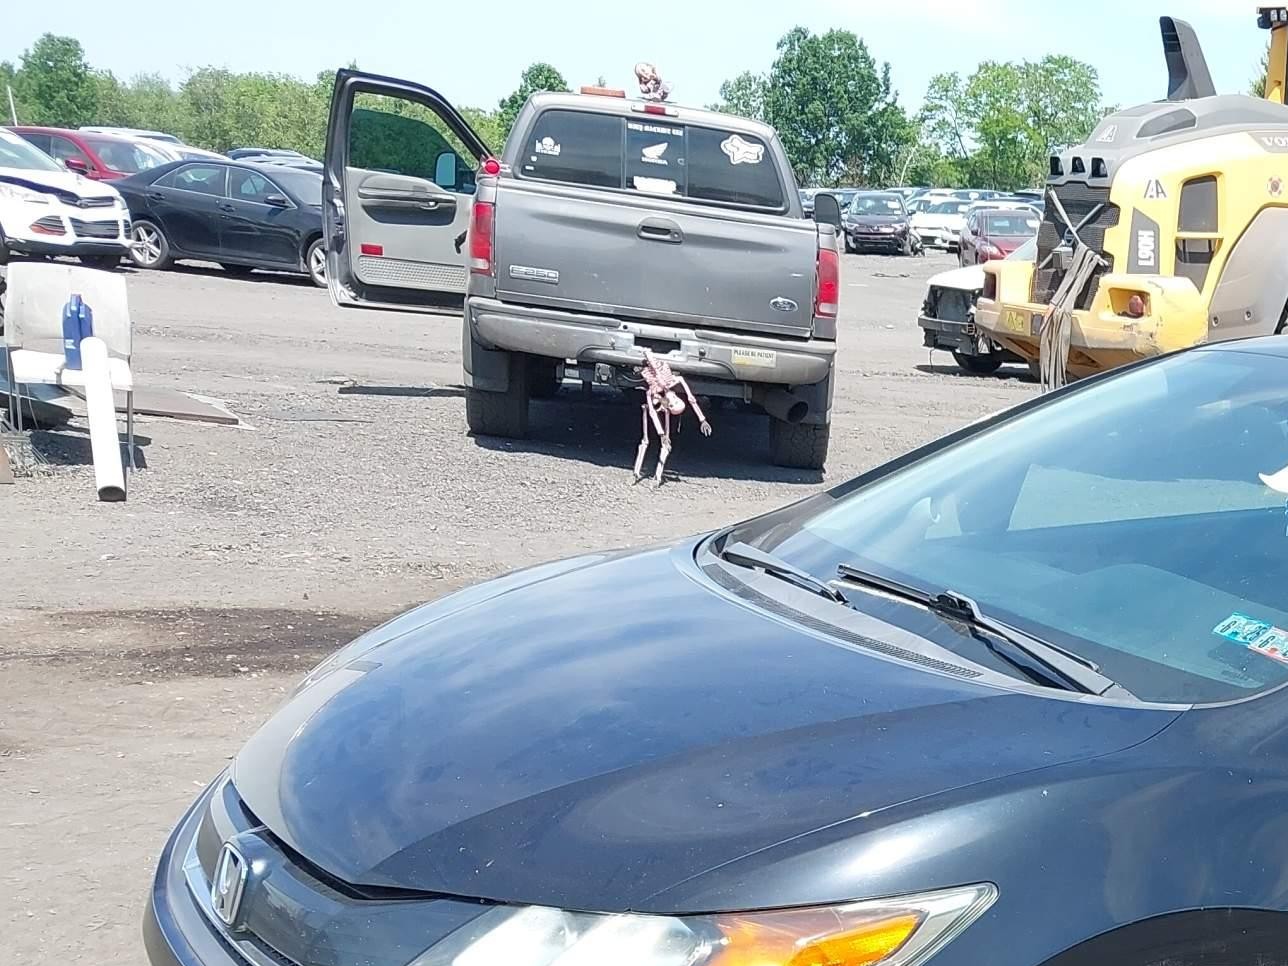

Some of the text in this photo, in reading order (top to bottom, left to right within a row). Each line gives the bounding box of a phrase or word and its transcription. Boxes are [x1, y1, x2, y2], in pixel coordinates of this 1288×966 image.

[1137, 230, 1155, 266] L90H
[733, 349, 750, 357] PLEASE
[757, 351, 774, 359] PATIENT
